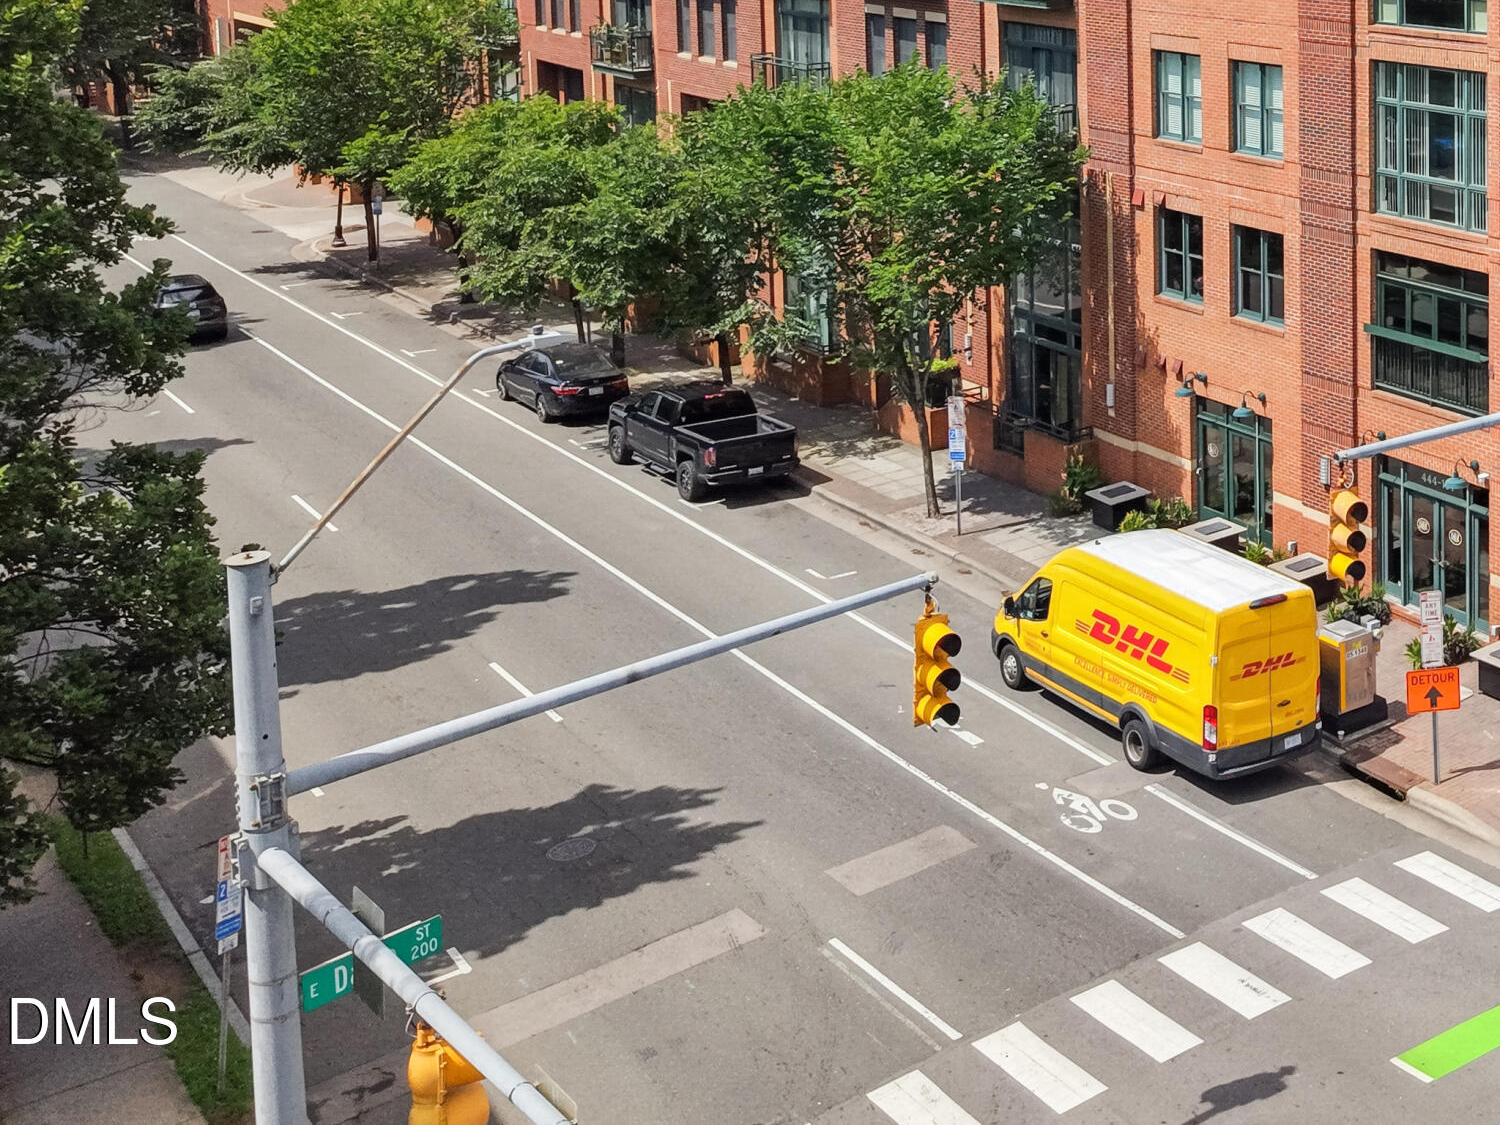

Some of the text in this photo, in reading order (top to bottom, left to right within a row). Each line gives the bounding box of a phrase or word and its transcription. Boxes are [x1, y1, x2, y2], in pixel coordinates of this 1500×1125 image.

[1421, 472, 1446, 489] 444-1
[1425, 609, 1438, 617] TIME
[1089, 608, 1173, 675] DHL
[1241, 651, 1296, 679] DHL
[1411, 671, 1456, 686] DETOUR
[415, 923, 431, 942] ST
[411, 937, 438, 962] 200
[309, 982, 319, 999] E
